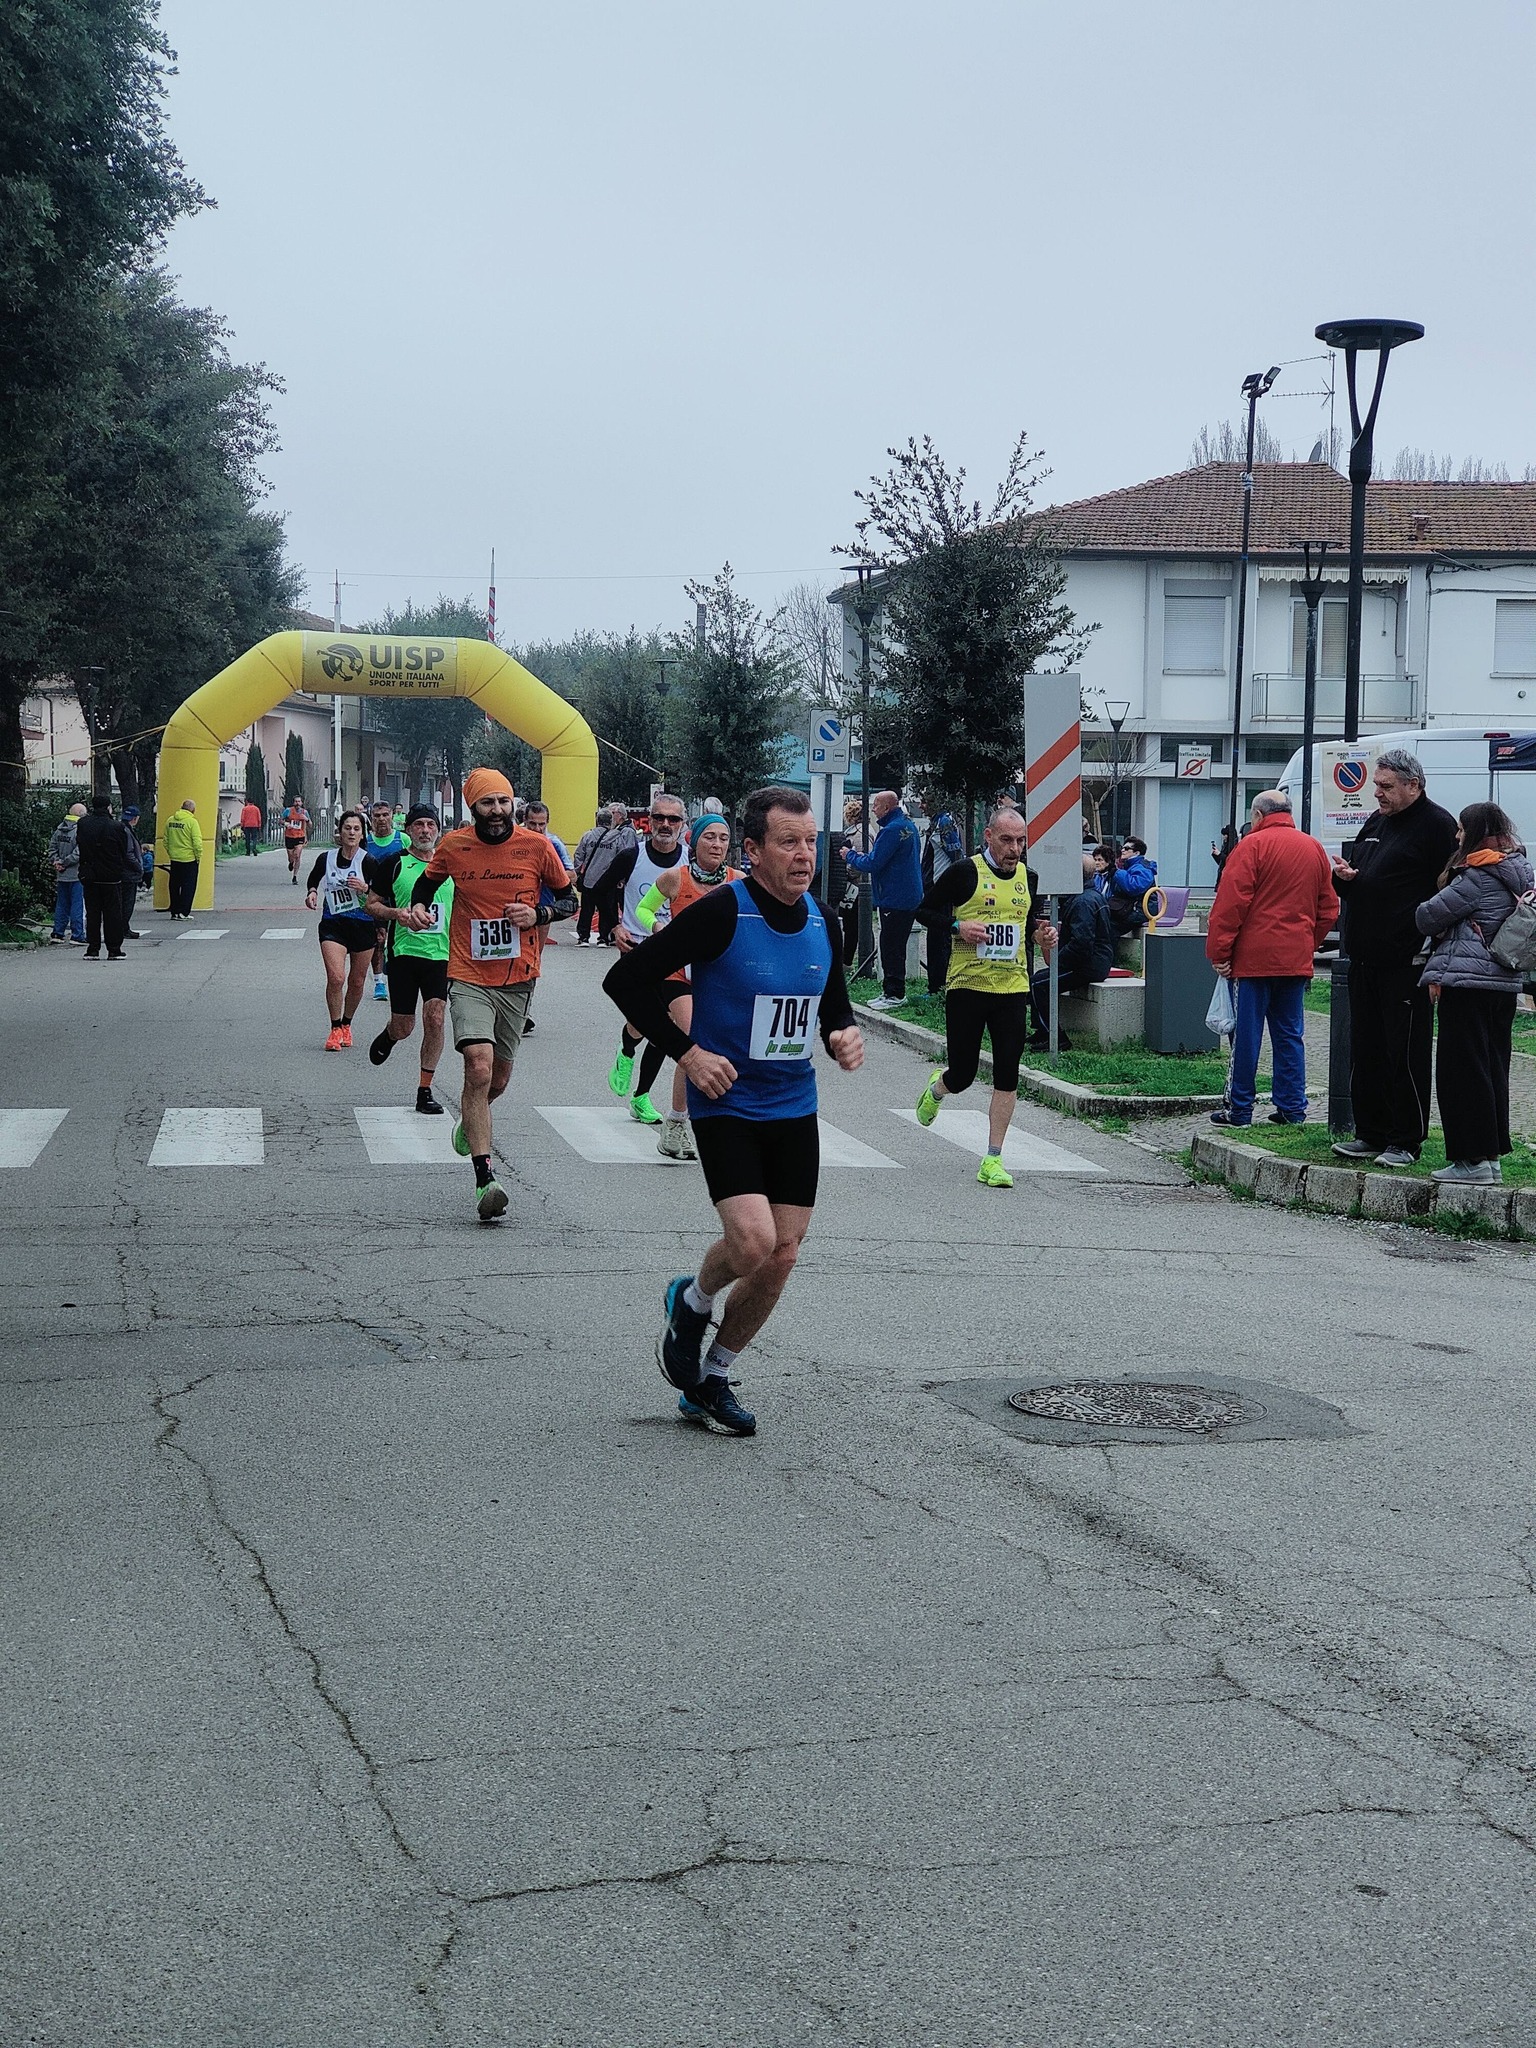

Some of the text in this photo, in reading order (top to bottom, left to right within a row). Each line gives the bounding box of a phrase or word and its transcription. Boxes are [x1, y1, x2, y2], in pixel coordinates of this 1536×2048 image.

[369, 645, 445, 670] UISP
[369, 671, 445, 681] UNIONE ITALIANA
[369, 679, 396, 687] SPORT
[399, 680, 414, 688] PER
[814, 750, 823, 760] P
[480, 868, 525, 880] Lamone
[331, 888, 353, 905] 709
[479, 919, 512, 946] 536
[769, 998, 810, 1038] 704
